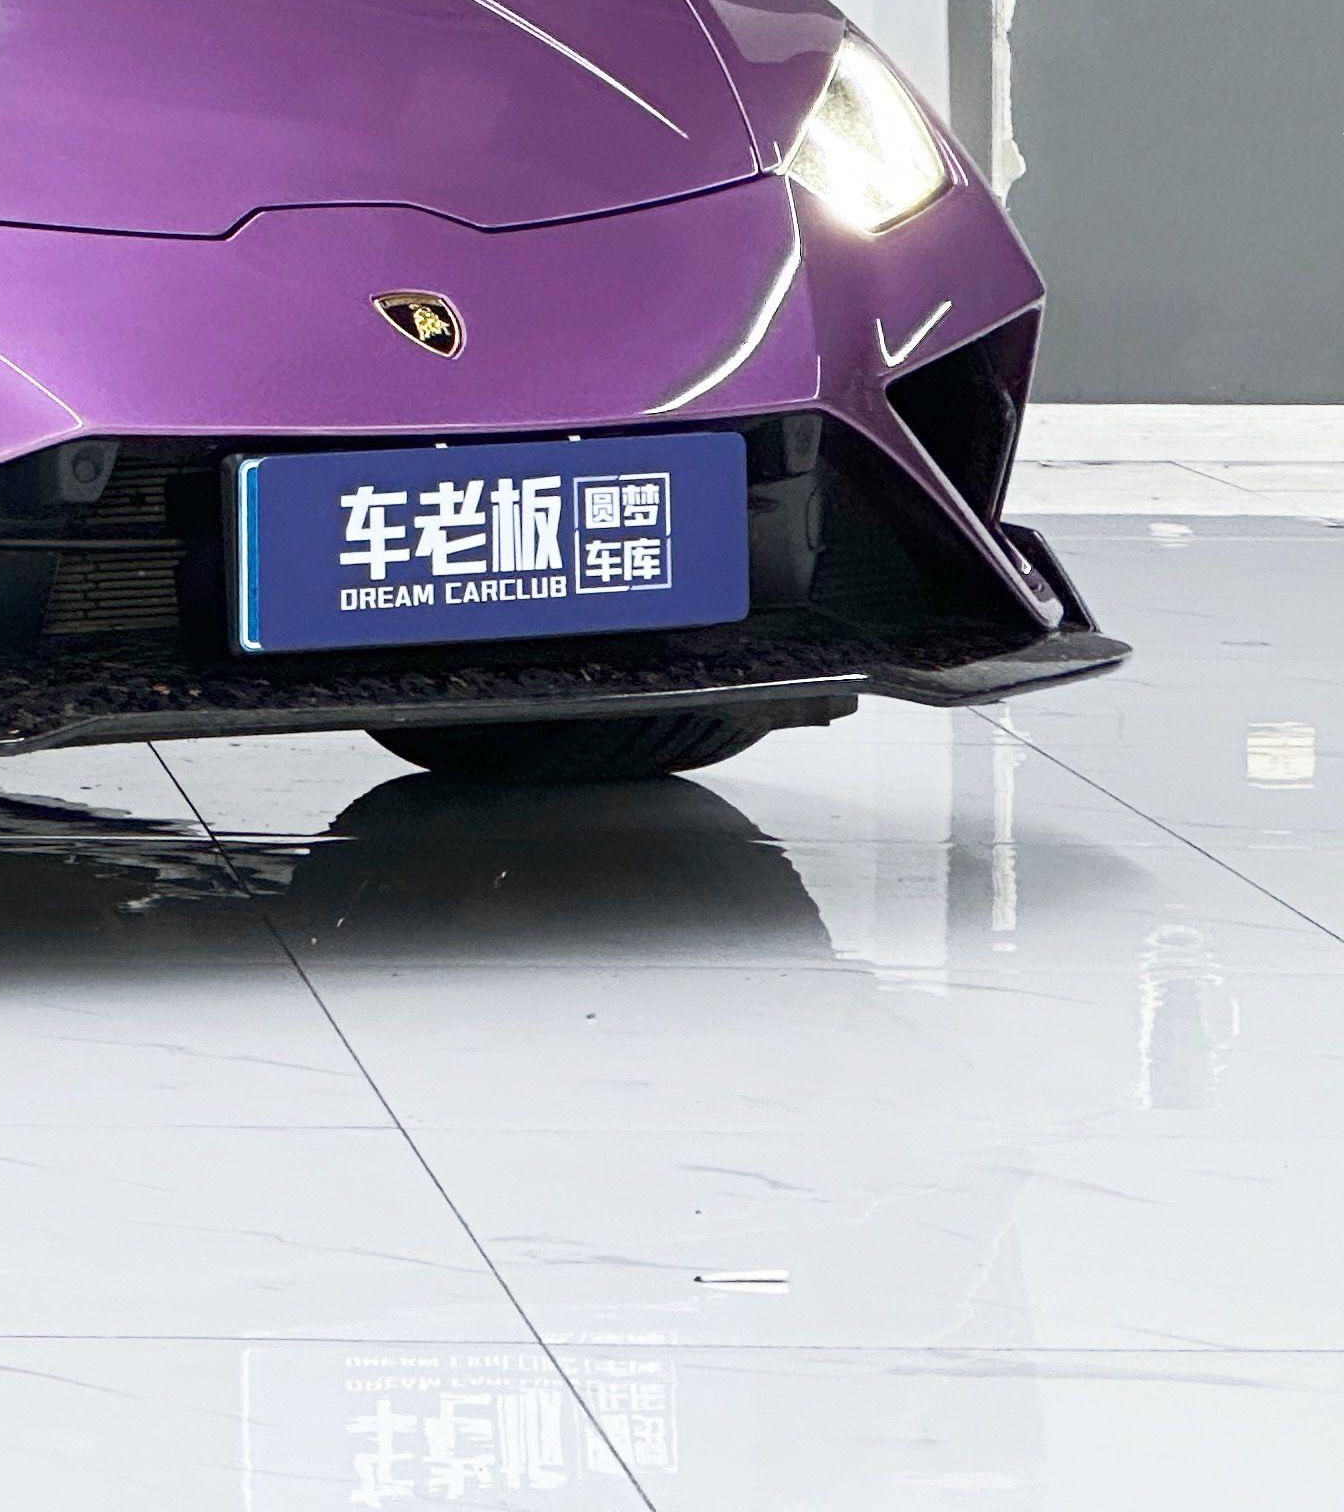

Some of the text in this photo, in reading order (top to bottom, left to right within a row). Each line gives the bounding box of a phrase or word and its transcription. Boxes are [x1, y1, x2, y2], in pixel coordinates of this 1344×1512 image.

[339, 475, 563, 580] 车老板
[584, 484, 660, 529] 圆梦
[585, 538, 661, 582] 车库
[340, 576, 567, 611] DREAM CARCLUB
